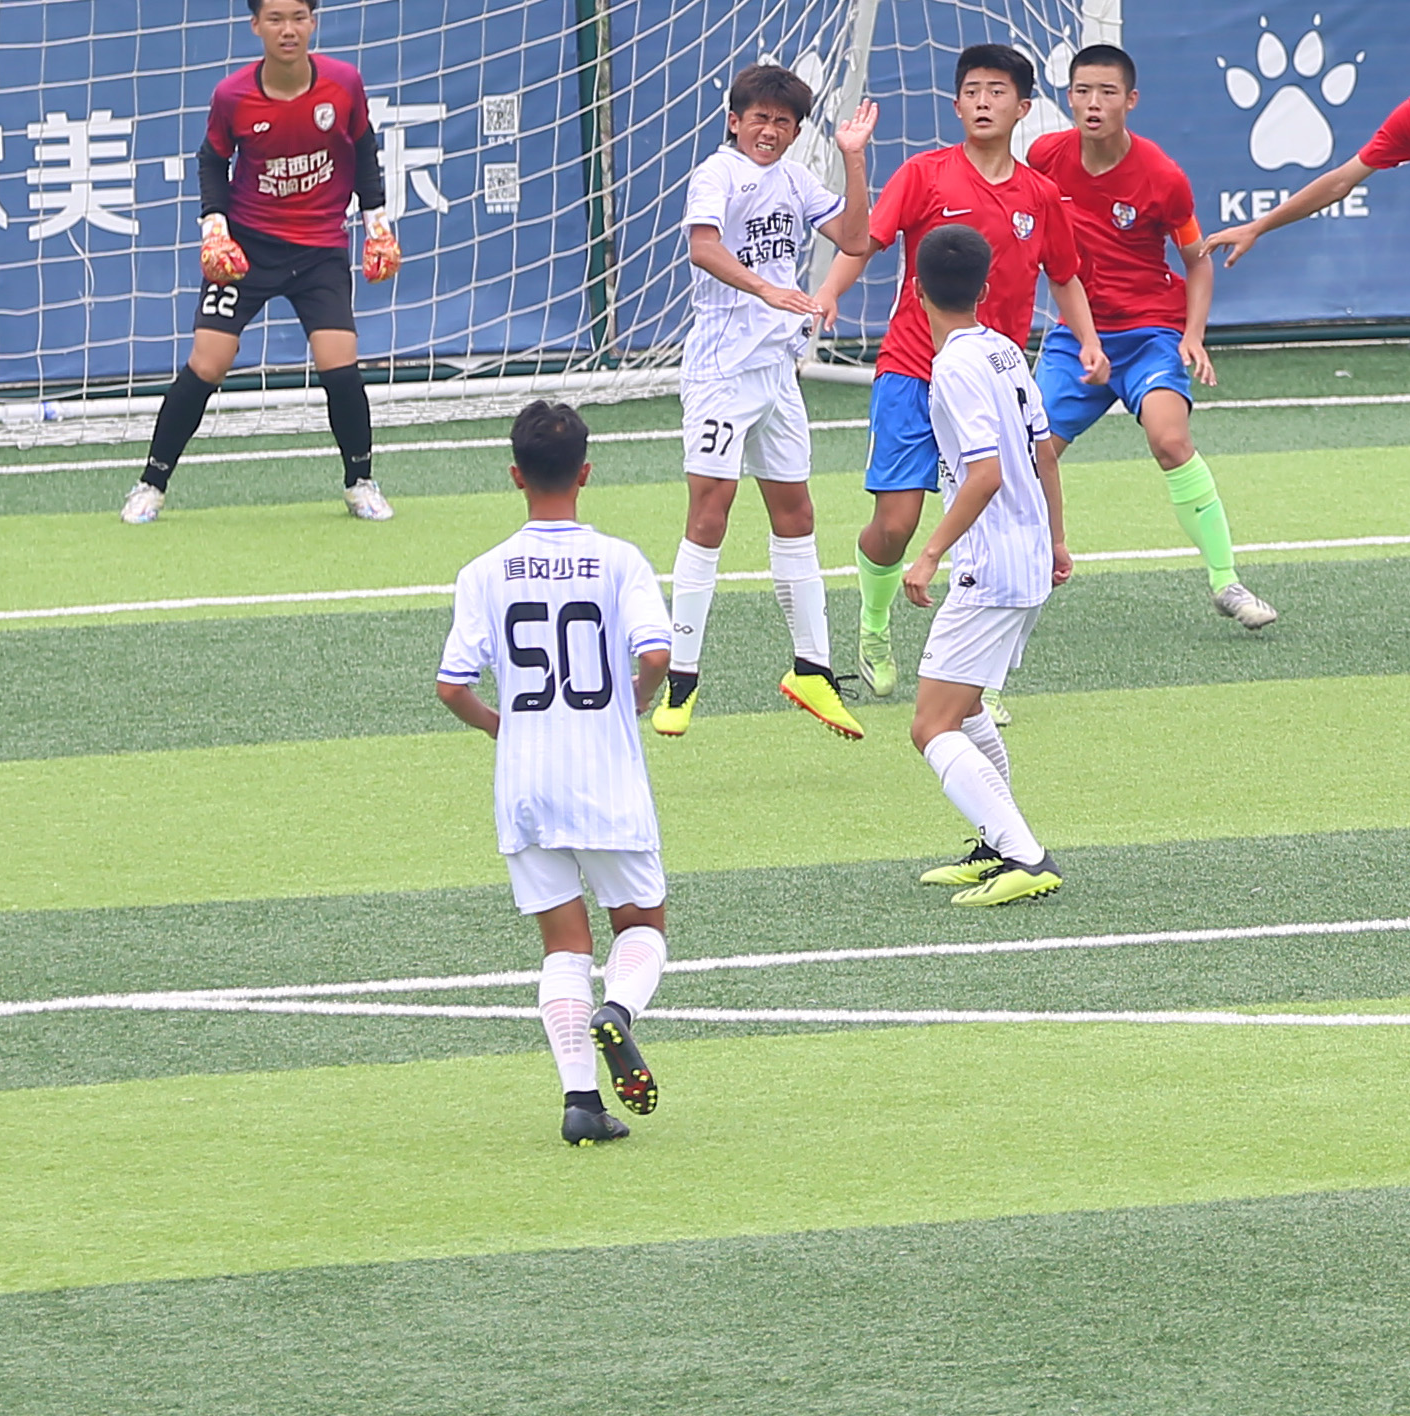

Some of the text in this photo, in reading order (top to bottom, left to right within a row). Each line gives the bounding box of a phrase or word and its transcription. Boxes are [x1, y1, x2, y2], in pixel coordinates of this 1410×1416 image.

[265, 149, 329, 177] 莱西市
[202, 283, 239, 318] 22
[700, 418, 733, 456] 37
[504, 601, 613, 712] 50
